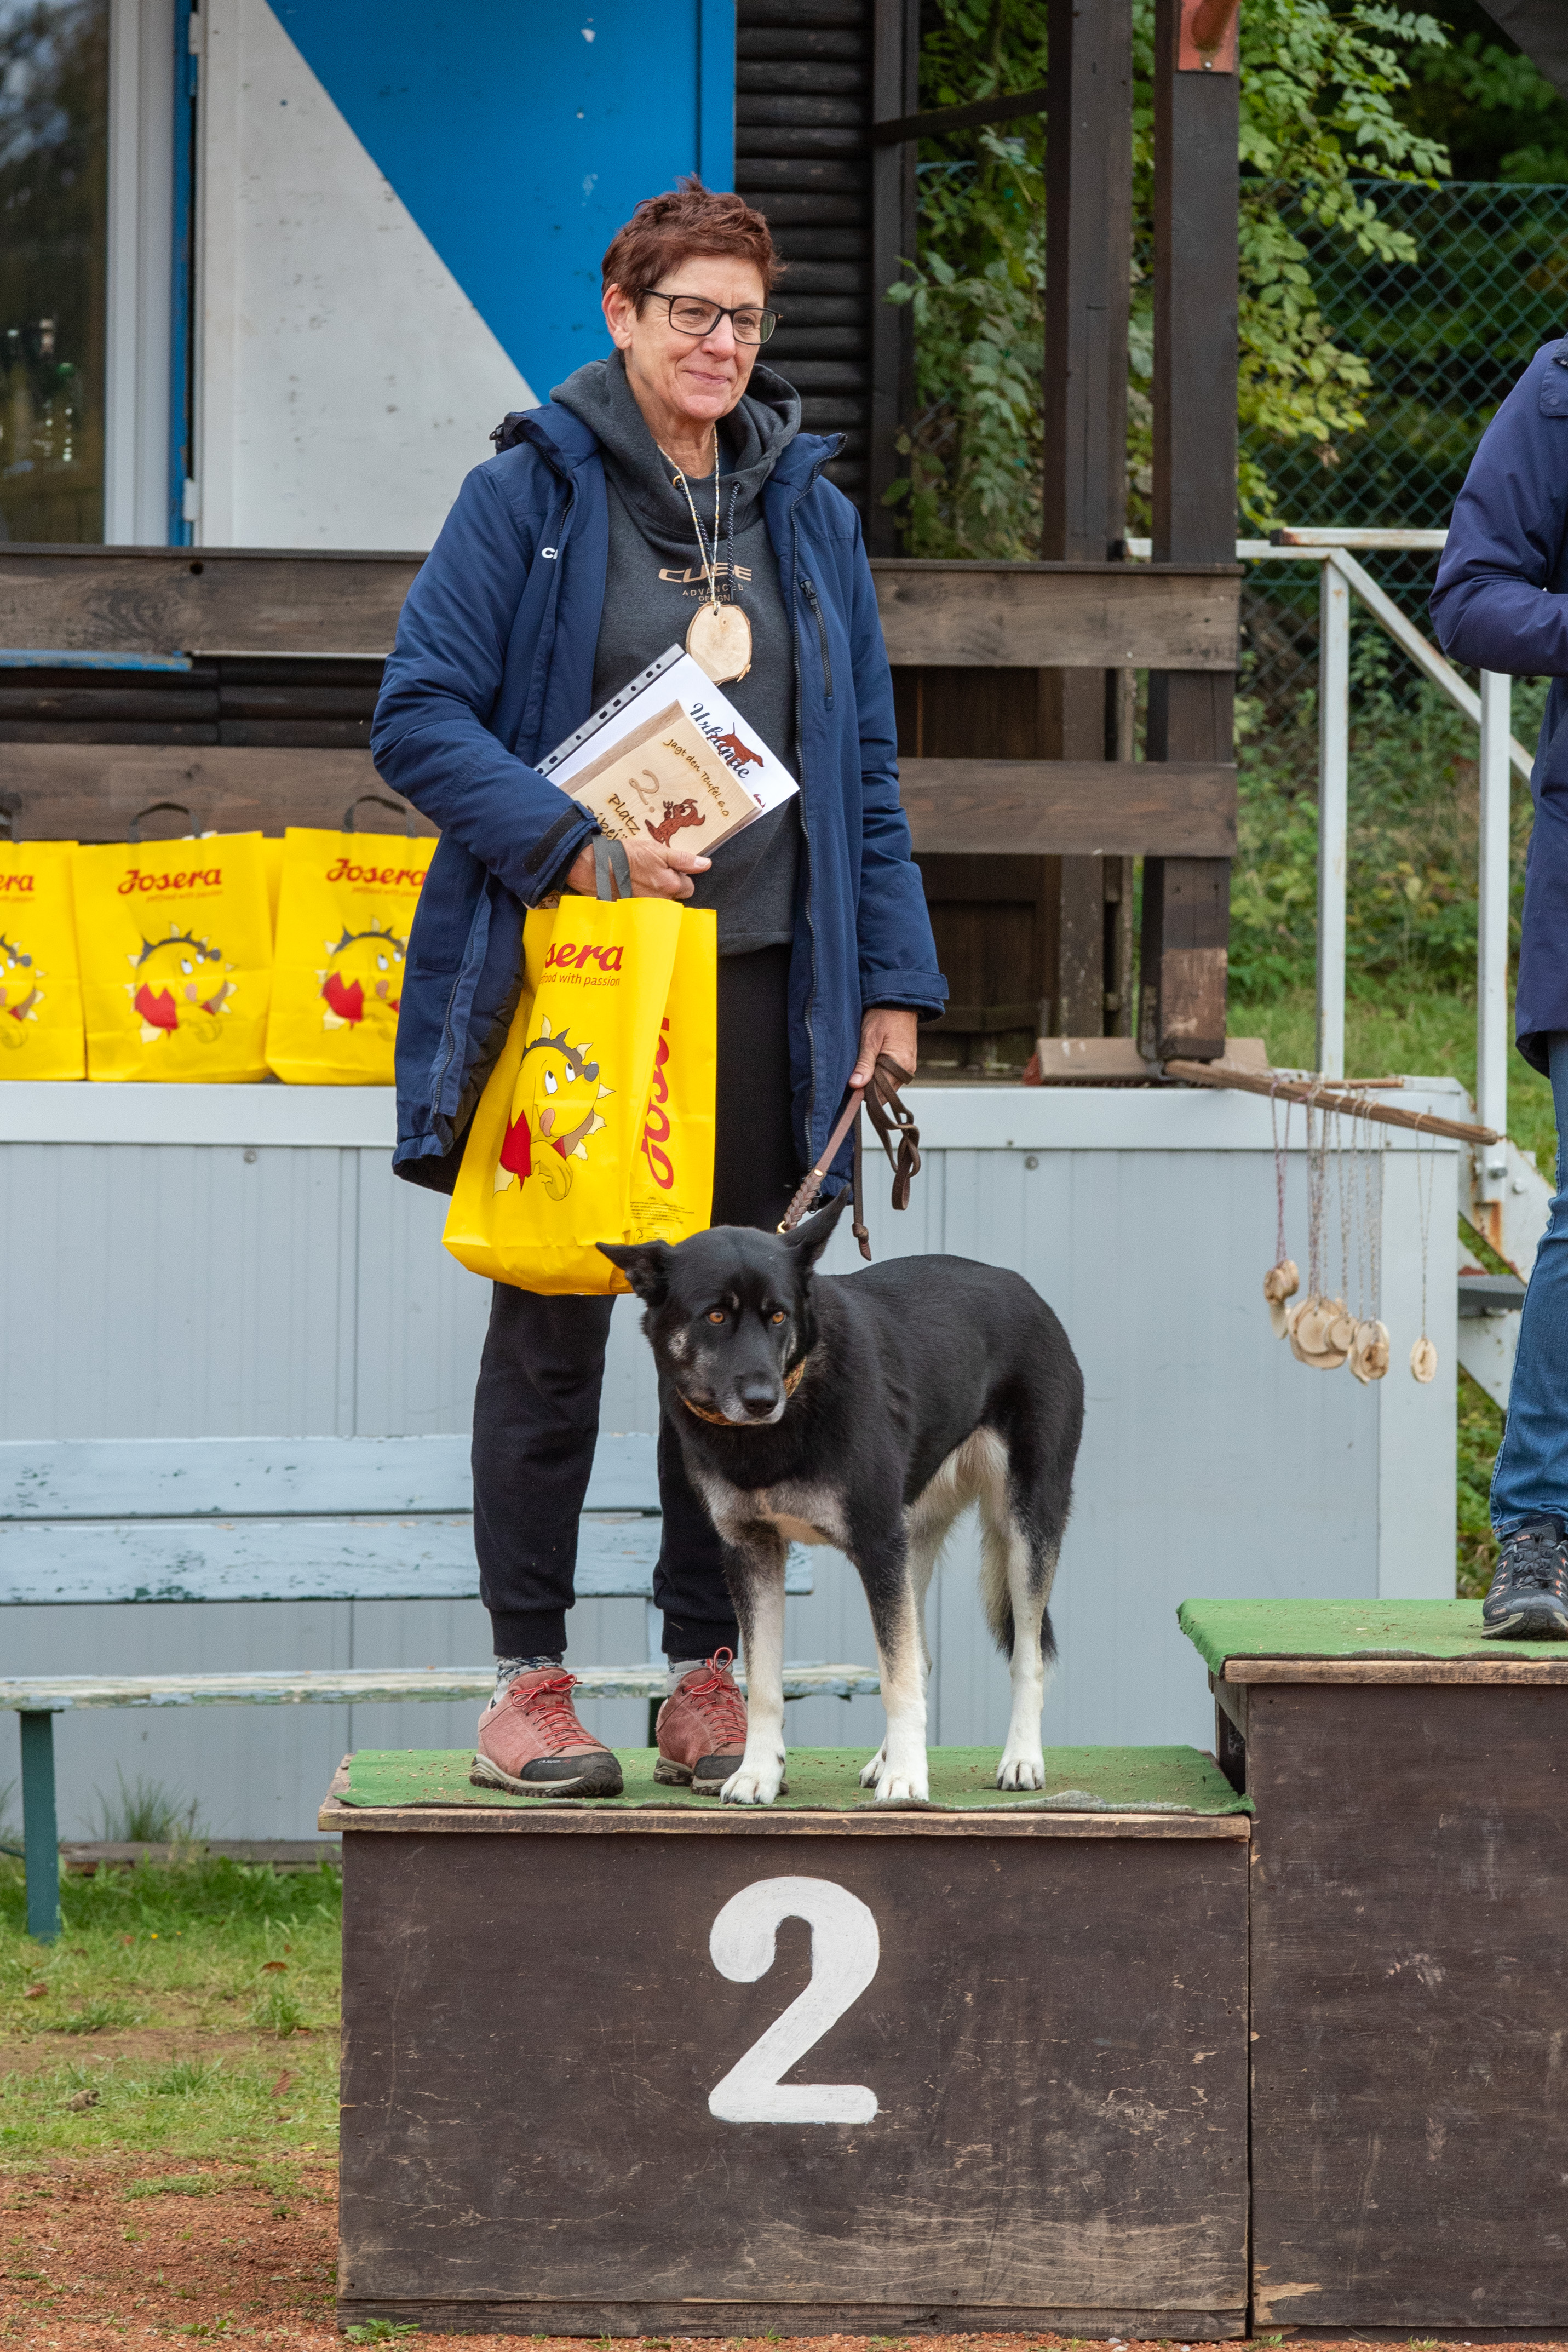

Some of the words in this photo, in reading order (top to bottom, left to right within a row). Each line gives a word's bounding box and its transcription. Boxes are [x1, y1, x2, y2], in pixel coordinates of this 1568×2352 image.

[686, 756, 700, 772] den
[717, 800, 730, 817] 6.0
[608, 793, 641, 835] Platz
[117, 869, 222, 894] Josera
[326, 858, 427, 886] Josera
[559, 973, 582, 984] with
[583, 976, 621, 988] passion
[708, 1875, 880, 2124] 2
